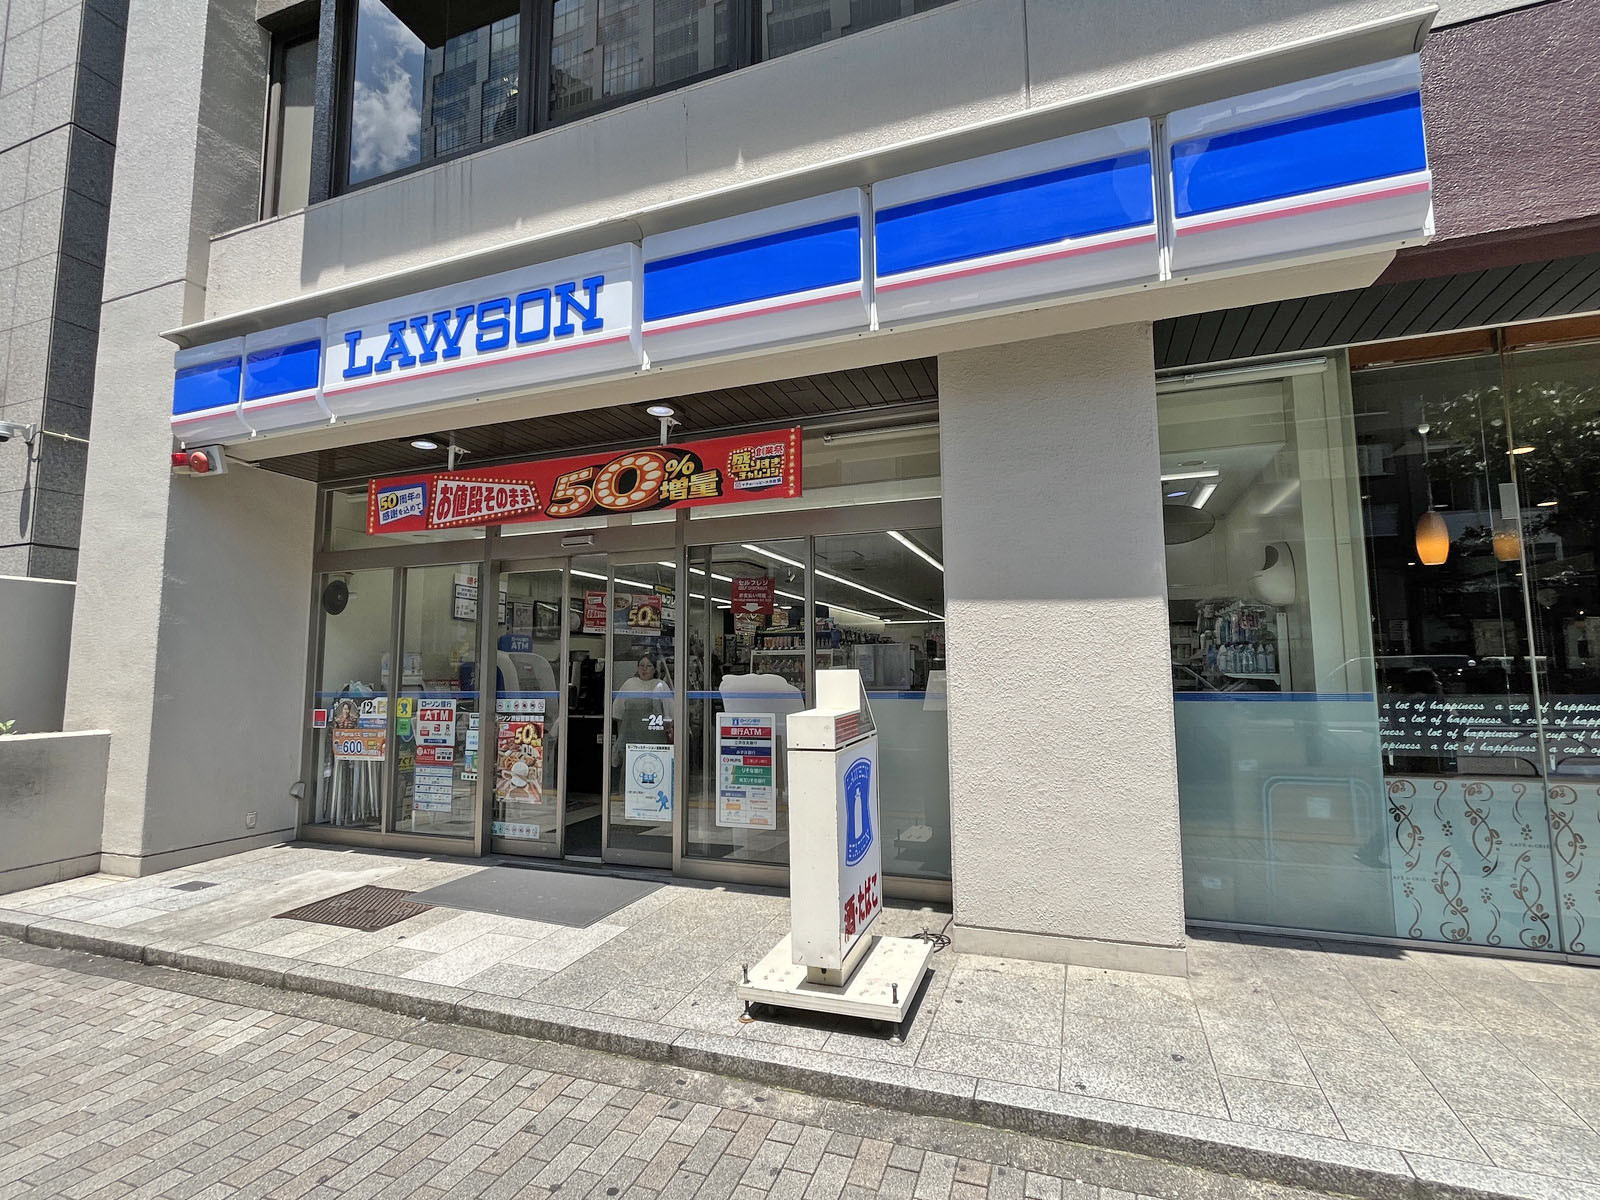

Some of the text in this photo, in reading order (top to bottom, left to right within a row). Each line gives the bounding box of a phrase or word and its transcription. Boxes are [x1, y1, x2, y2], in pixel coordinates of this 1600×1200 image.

[342, 275, 605, 379] LAWSON
[659, 470, 721, 501] 増量
[436, 483, 533, 521] お値段そのまま
[382, 502, 422, 522] 感謝を込めて
[421, 700, 453, 708] ローソン銀行
[1395, 701, 1410, 710] lot
[1414, 701, 1426, 712] of
[1430, 701, 1486, 712] happiness
[1508, 703, 1530, 713] cup
[424, 709, 449, 721] ATM
[648, 714, 664, 726] 24
[1411, 714, 1427, 723] lot
[1430, 714, 1443, 726] of
[1446, 714, 1502, 726] happiness
[1554, 716, 1567, 727] of
[1414, 729, 1422, 737] a
[1427, 727, 1443, 737] lot
[1446, 728, 1459, 740] of
[1463, 728, 1519, 740] happiness
[1545, 731, 1567, 741] cup
[1572, 730, 1586, 742] of
[343, 740, 362, 754] 600
[1443, 742, 1459, 751] lot
[1463, 742, 1475, 754] of
[1480, 742, 1537, 754] happiness
[1563, 745, 1586, 756] cup
